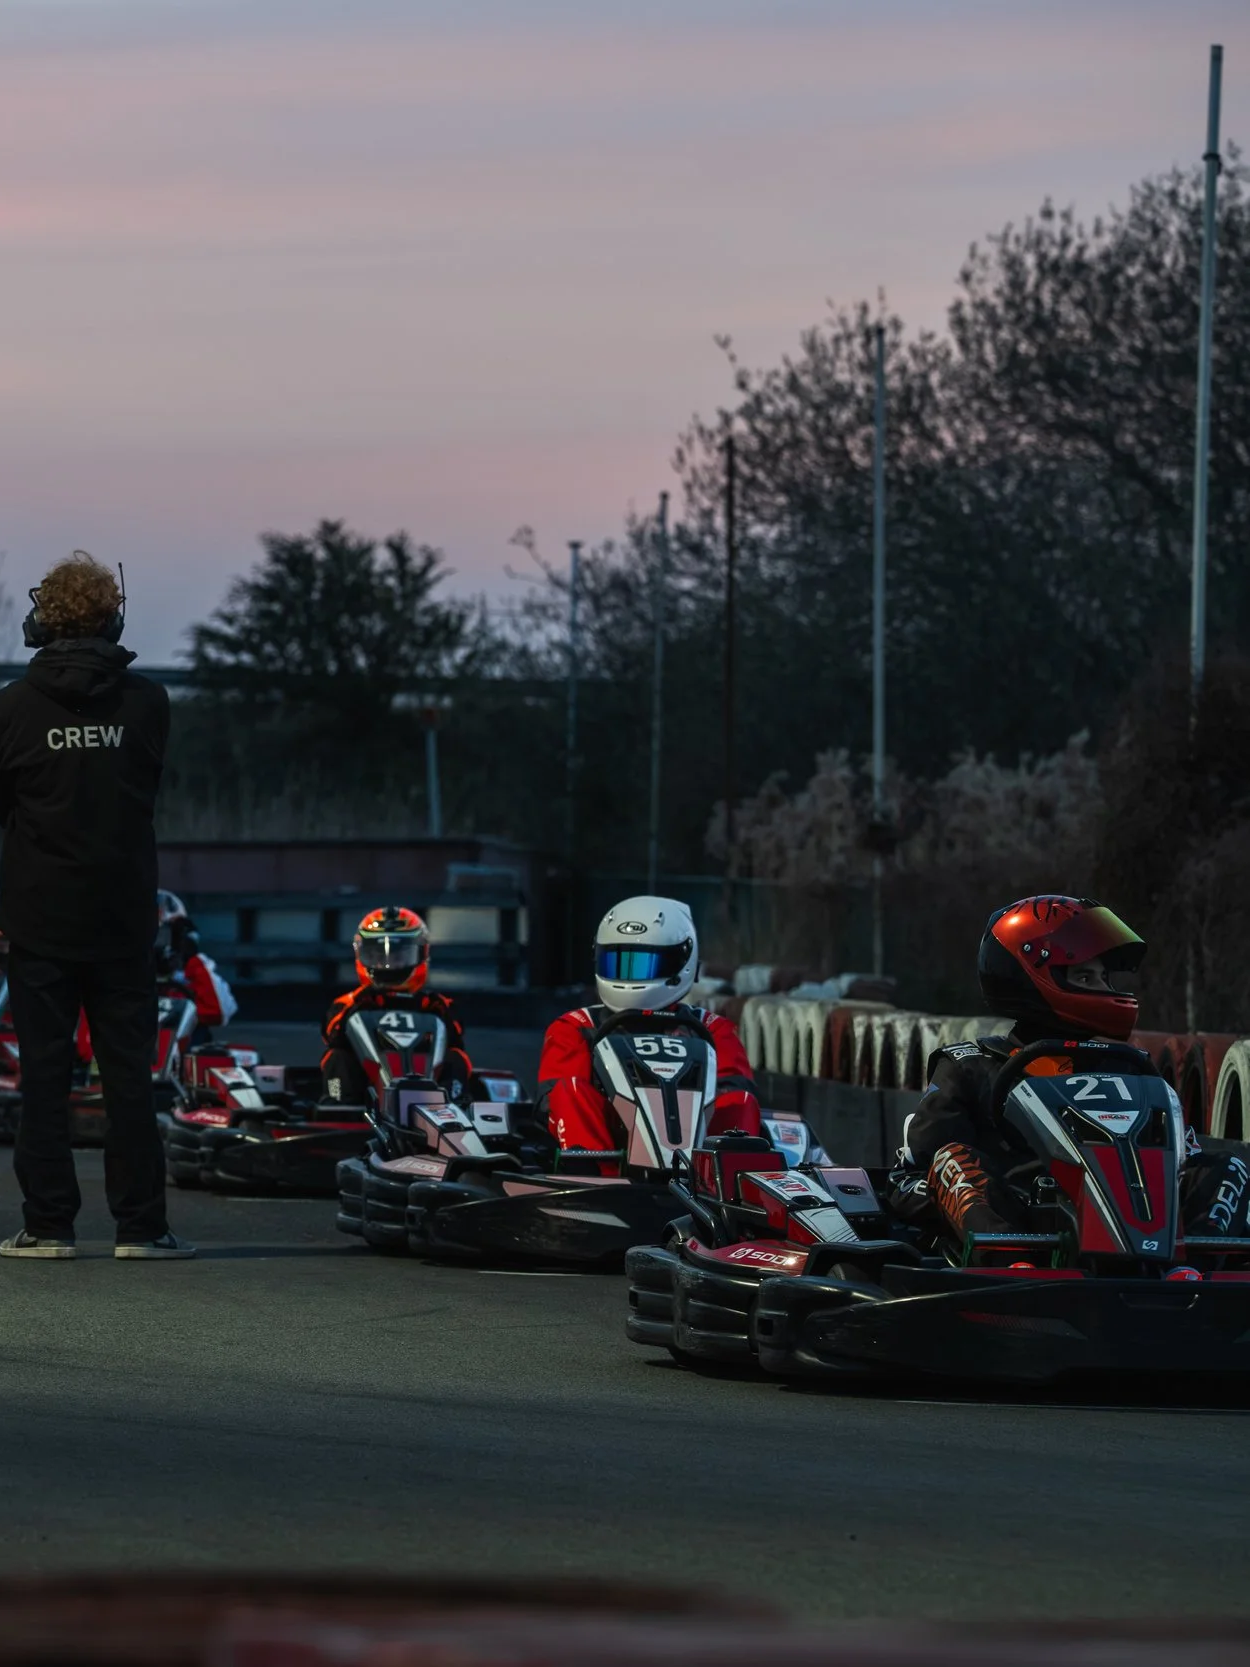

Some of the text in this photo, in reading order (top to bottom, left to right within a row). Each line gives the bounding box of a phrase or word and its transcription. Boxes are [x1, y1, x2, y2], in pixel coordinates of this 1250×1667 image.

[47, 725, 125, 751] CREW
[378, 1012, 415, 1029] 41
[633, 1036, 687, 1058] 55
[1078, 1041, 1110, 1049] SODI
[1065, 1076, 1133, 1101] 21
